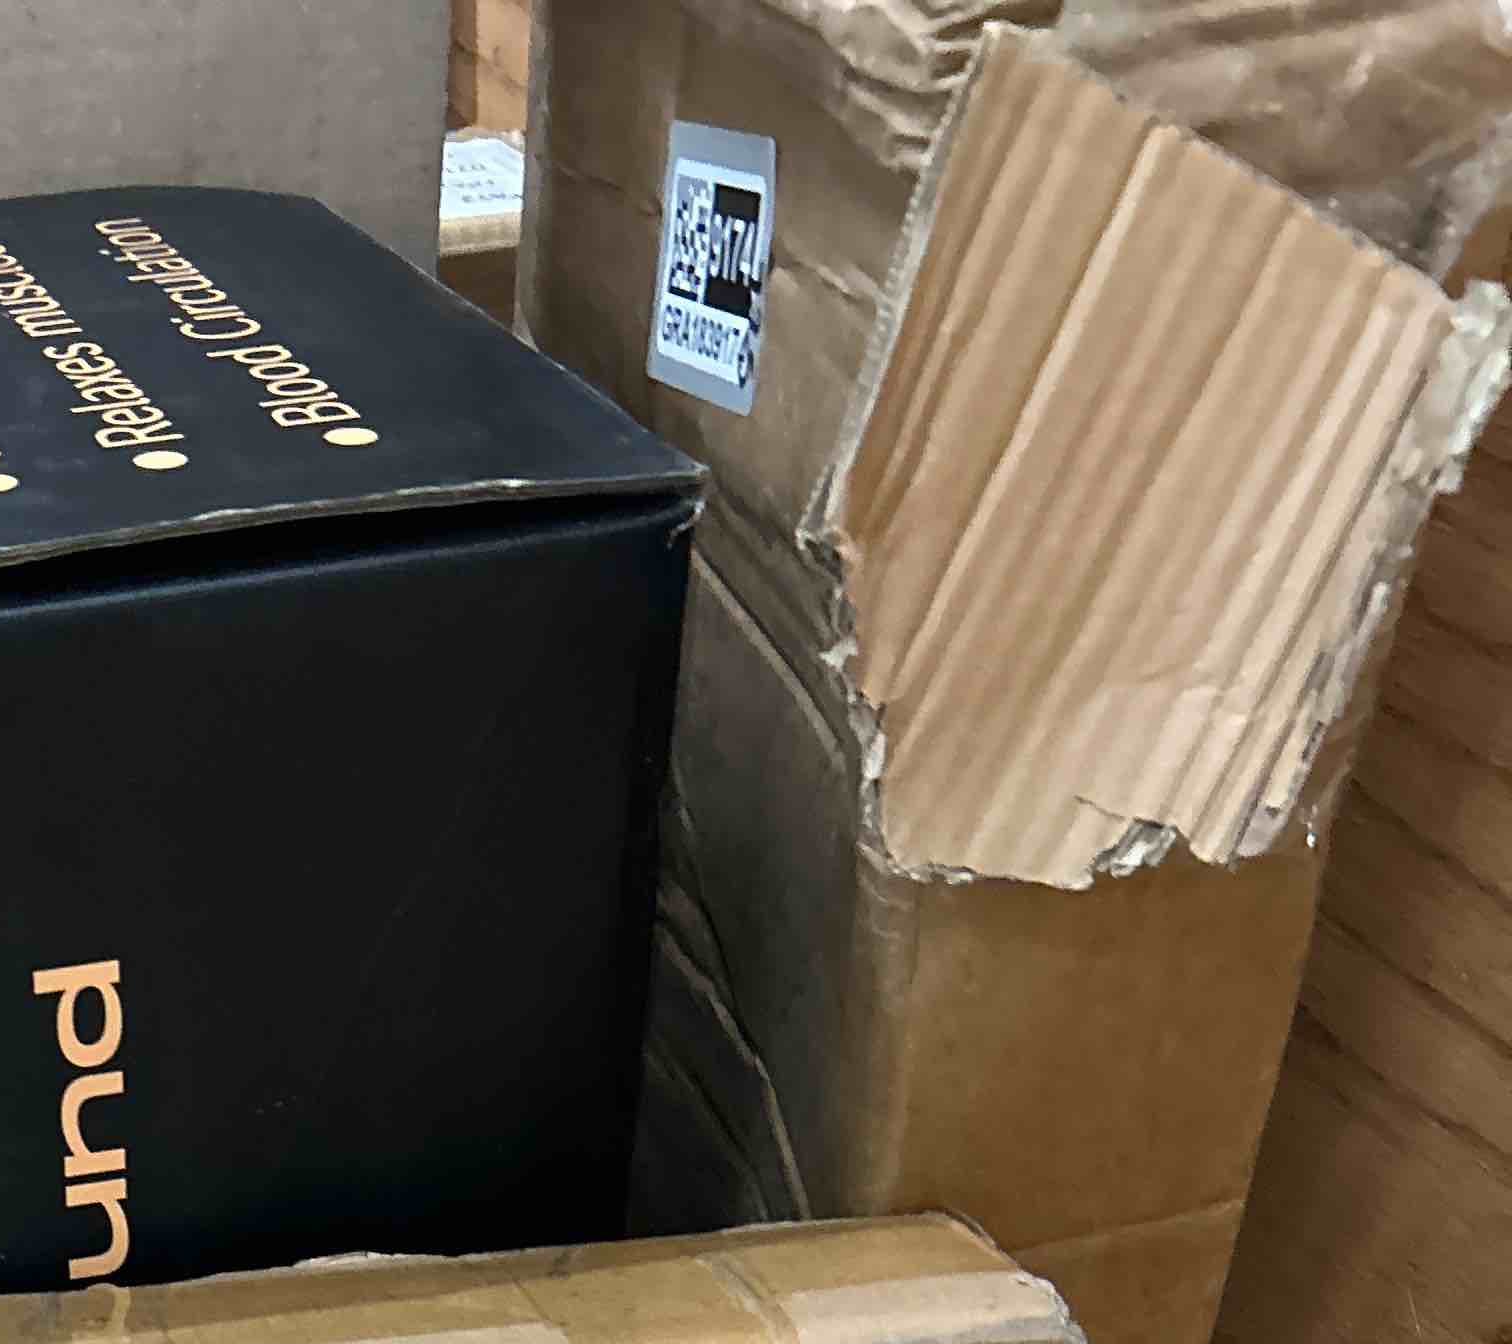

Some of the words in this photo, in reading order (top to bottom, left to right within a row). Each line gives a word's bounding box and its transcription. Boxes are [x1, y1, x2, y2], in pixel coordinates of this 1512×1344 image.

[93, 216, 263, 340] Circulation
[42, 342, 186, 450] Relaxes
[204, 344, 362, 428] Blood
[32, 959, 130, 1281] und
